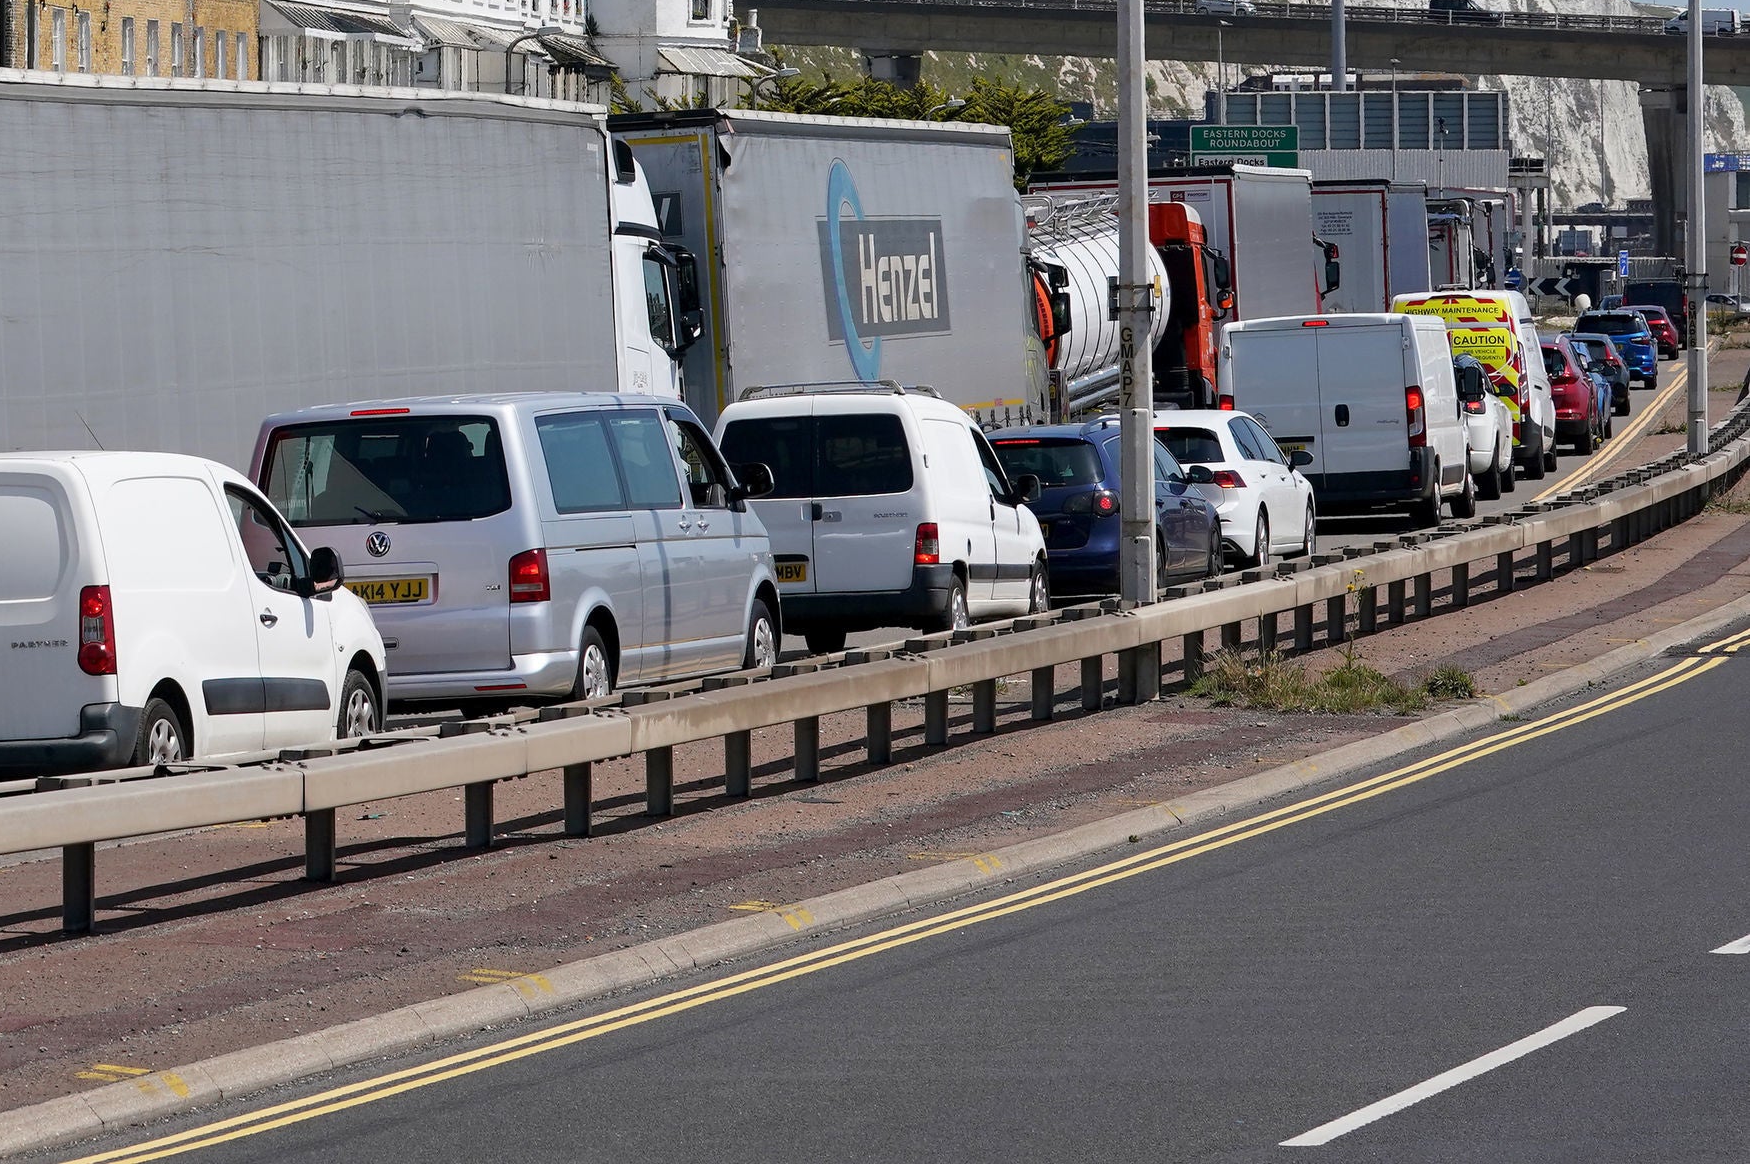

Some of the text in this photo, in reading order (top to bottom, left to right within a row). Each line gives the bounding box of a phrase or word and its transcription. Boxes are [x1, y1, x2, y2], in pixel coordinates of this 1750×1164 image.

[1203, 129, 1286, 138] EASTERN DOCKS
[1210, 139, 1280, 148] ROUNDABOUT
[1198, 158, 1265, 167] Eastern Docks
[858, 232, 938, 323] Henzel
[1453, 335, 1505, 345] CAUTION
[390, 582, 422, 598] YJJ
[10, 640, 69, 650] PARTNER
